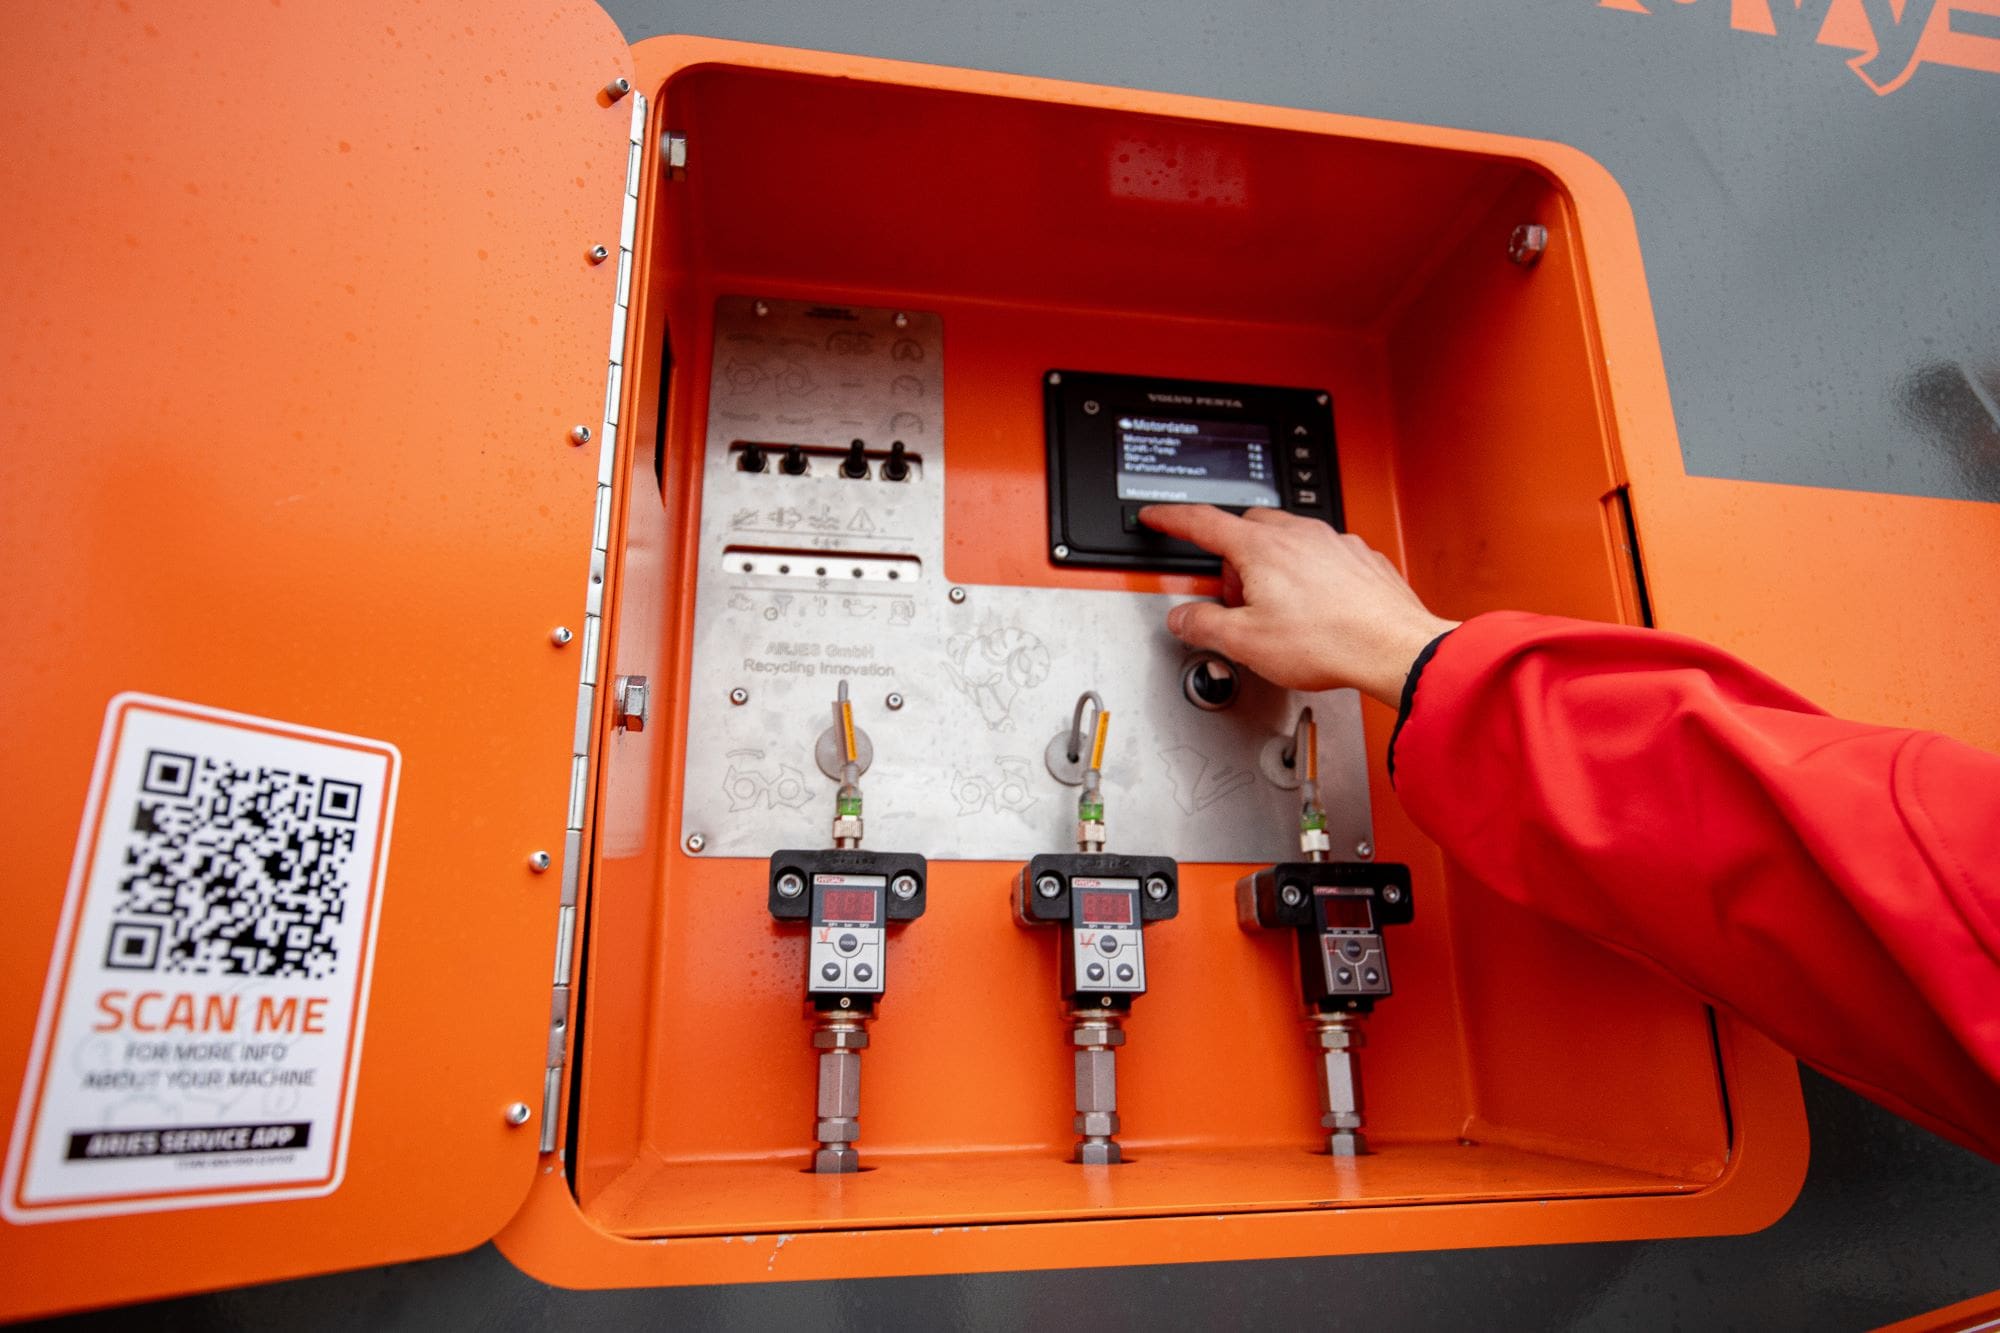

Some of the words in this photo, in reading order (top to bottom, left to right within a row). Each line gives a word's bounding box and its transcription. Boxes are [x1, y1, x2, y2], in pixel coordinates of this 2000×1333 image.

[1147, 393, 1193, 405] VOLVO
[1196, 396, 1243, 409] PENTA
[1132, 418, 1199, 434] Motordaten
[825, 643, 875, 658] GmbH
[744, 659, 815, 677] Recycling
[820, 661, 895, 677] Innovation
[93, 989, 239, 1034] SCAN
[254, 996, 329, 1034] ME
[124, 1041, 169, 1062] FOR
[172, 1041, 235, 1062] MORE
[241, 1042, 288, 1062] INFO
[84, 1069, 159, 1089] ABOUT
[166, 1068, 223, 1088] YOUR
[227, 1068, 316, 1087] MACHINE
[160, 1128, 251, 1154] SERVICE
[251, 1126, 297, 1148] APP
